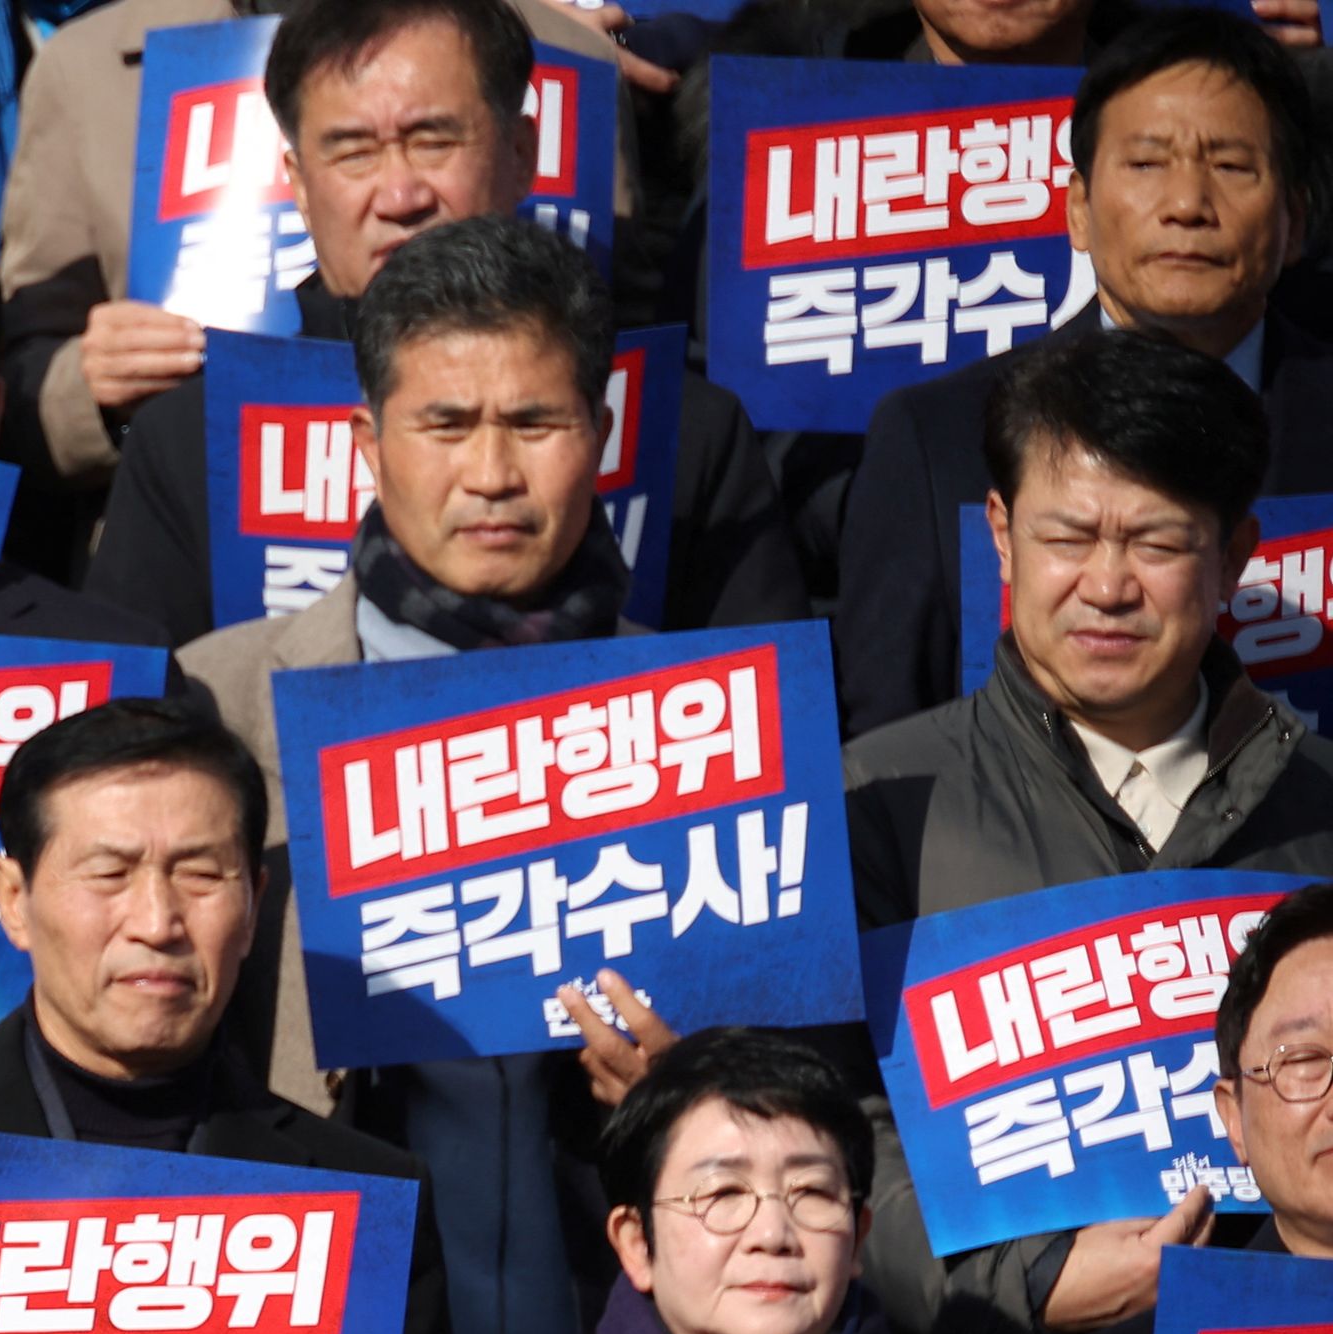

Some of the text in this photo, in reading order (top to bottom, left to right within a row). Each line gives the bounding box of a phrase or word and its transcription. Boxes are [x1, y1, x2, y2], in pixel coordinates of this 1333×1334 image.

[764, 114, 1074, 246] 내란행
[764, 250, 1098, 375] 즉각수
[342, 666, 762, 870] 내란행위
[359, 800, 810, 1001] 즉각수사!
